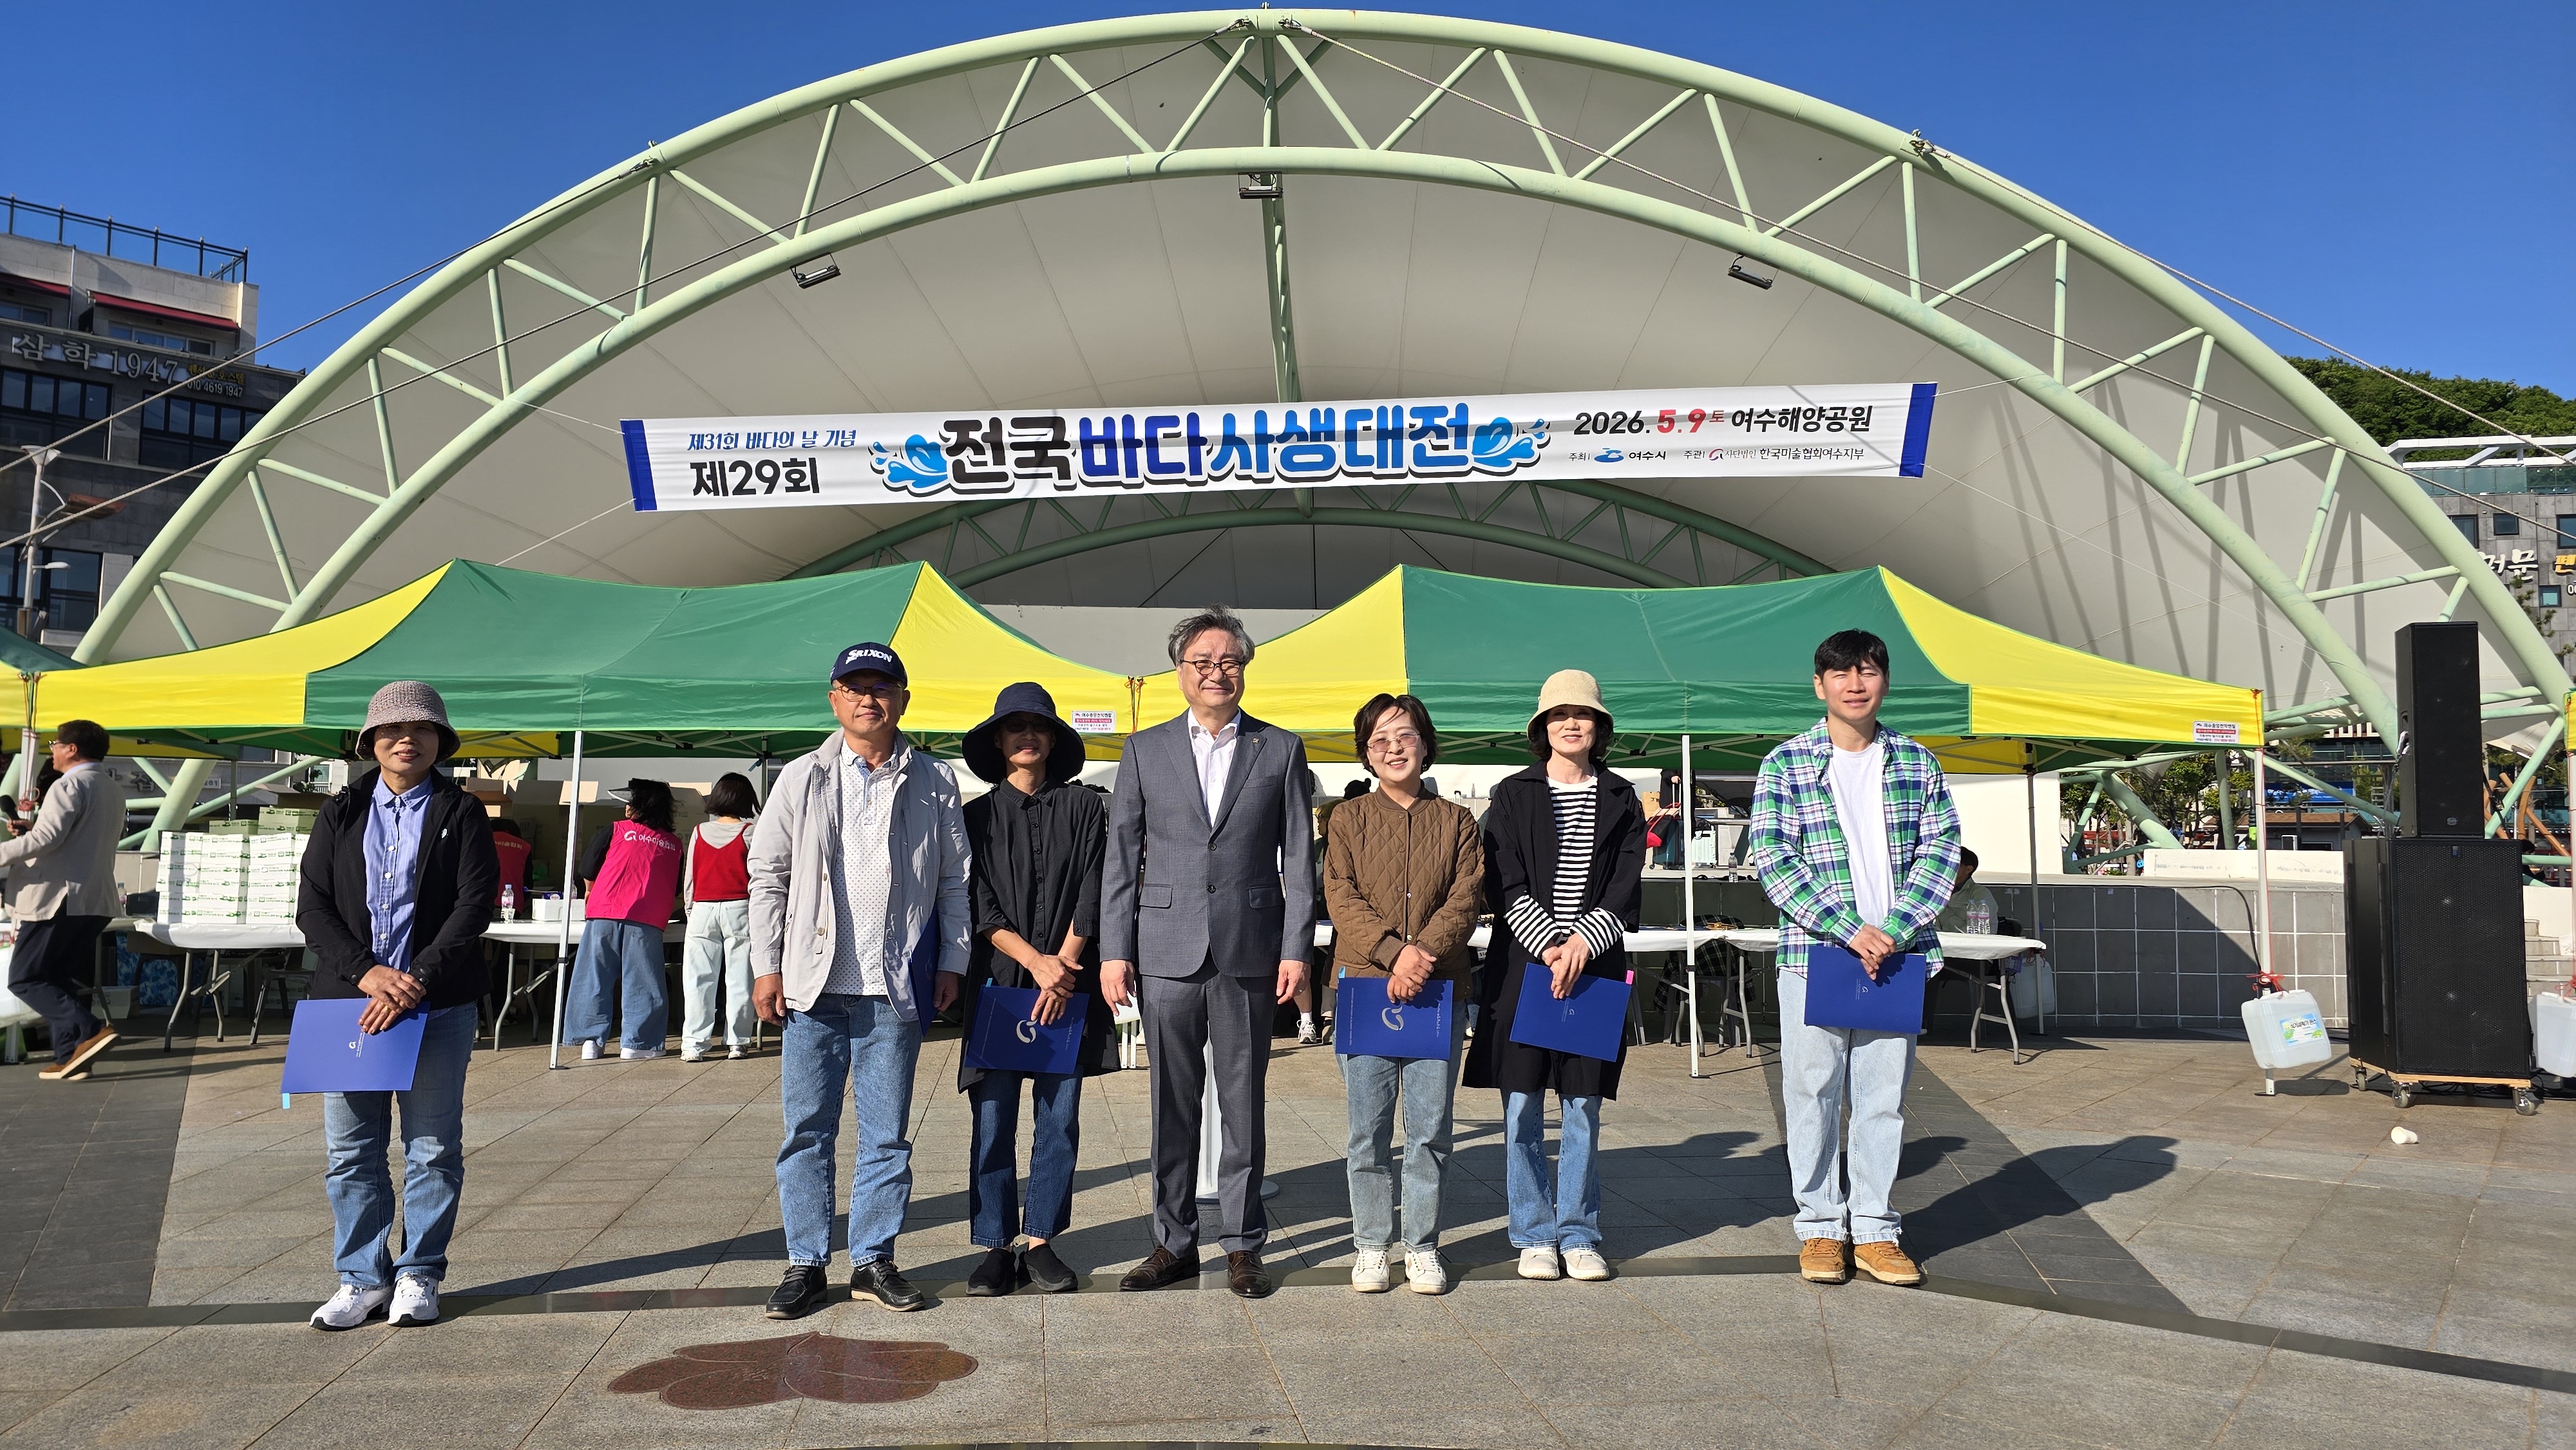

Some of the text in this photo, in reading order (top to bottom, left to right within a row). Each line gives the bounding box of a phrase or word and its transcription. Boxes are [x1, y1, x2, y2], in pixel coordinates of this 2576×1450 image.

[111, 348, 178, 384] 1947
[204, 381, 223, 394] 4619
[225, 385, 243, 397] 1947
[1709, 410, 1725, 422] 토
[1731, 405, 1873, 432] 여수해양공원
[687, 429, 857, 451] 제31회 바다의 날 기념
[1629, 451, 1667, 460] 여수시
[1725, 449, 1757, 459] 사단법인
[1759, 447, 1864, 460] 한국미술협회여수지부
[689, 457, 820, 496] 제29회
[845, 649, 893, 665] SRIXON
